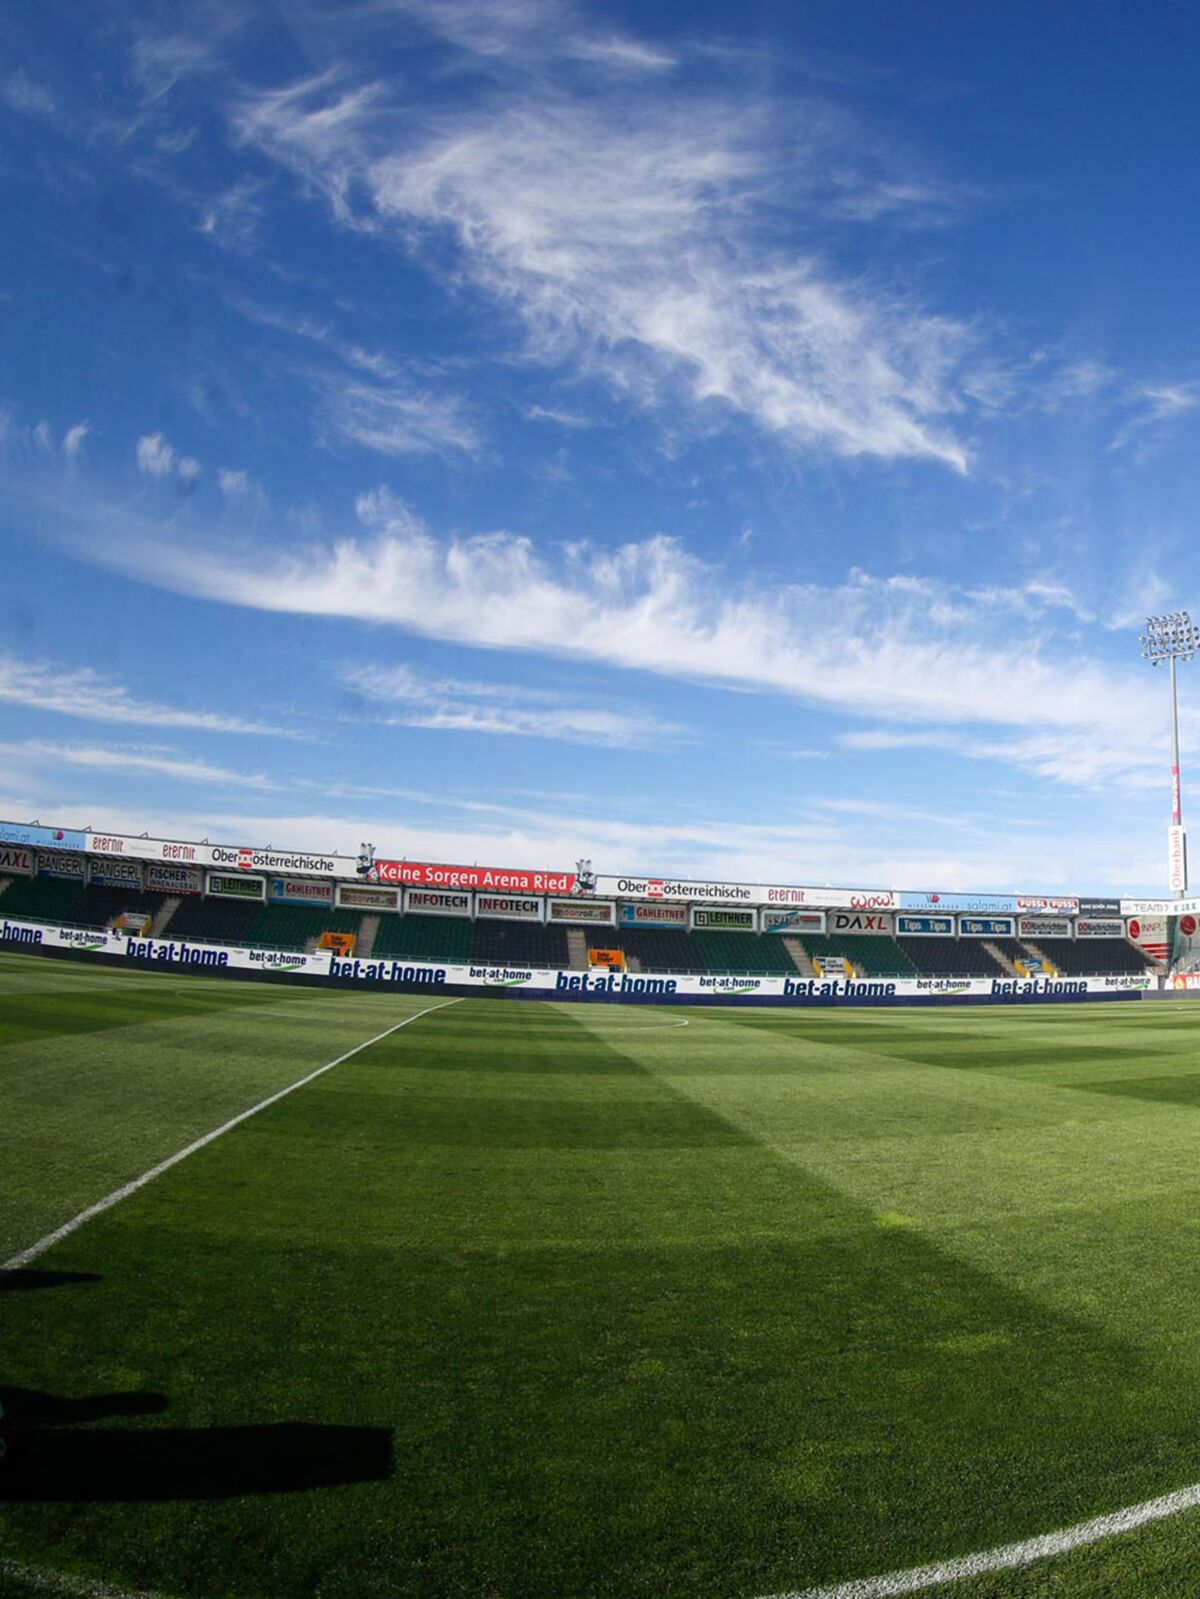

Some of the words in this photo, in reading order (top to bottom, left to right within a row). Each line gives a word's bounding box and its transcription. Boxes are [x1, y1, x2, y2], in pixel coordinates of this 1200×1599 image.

[93, 836, 124, 853] eternit
[162, 844, 195, 860] eternit
[0, 851, 30, 869] AXL
[150, 868, 187, 881] FISCHER
[380, 863, 420, 880] Keine
[425, 867, 478, 886] Sorgen
[483, 871, 528, 888] Arena
[534, 875, 567, 890] Ried
[409, 892, 468, 908] INFOTECH
[768, 888, 805, 902] eternit
[479, 898, 539, 912] INFOTECH
[710, 911, 752, 924] LEITHNER
[904, 919, 922, 931] Tips
[929, 919, 947, 931] Tips
[966, 920, 983, 933] Tips
[60, 929, 108, 945] bet-at-home
[127, 937, 228, 966] bet-at-home
[249, 950, 307, 965] bet-at-home
[330, 957, 447, 984] bet-at-home
[469, 967, 532, 980] bet-at-home
[556, 970, 677, 993] bet-at-home
[699, 976, 761, 987] bet-at-home
[783, 978, 896, 996] bet-at-home
[917, 979, 971, 989] bet-at-home
[991, 979, 1088, 995] bet-at-home
